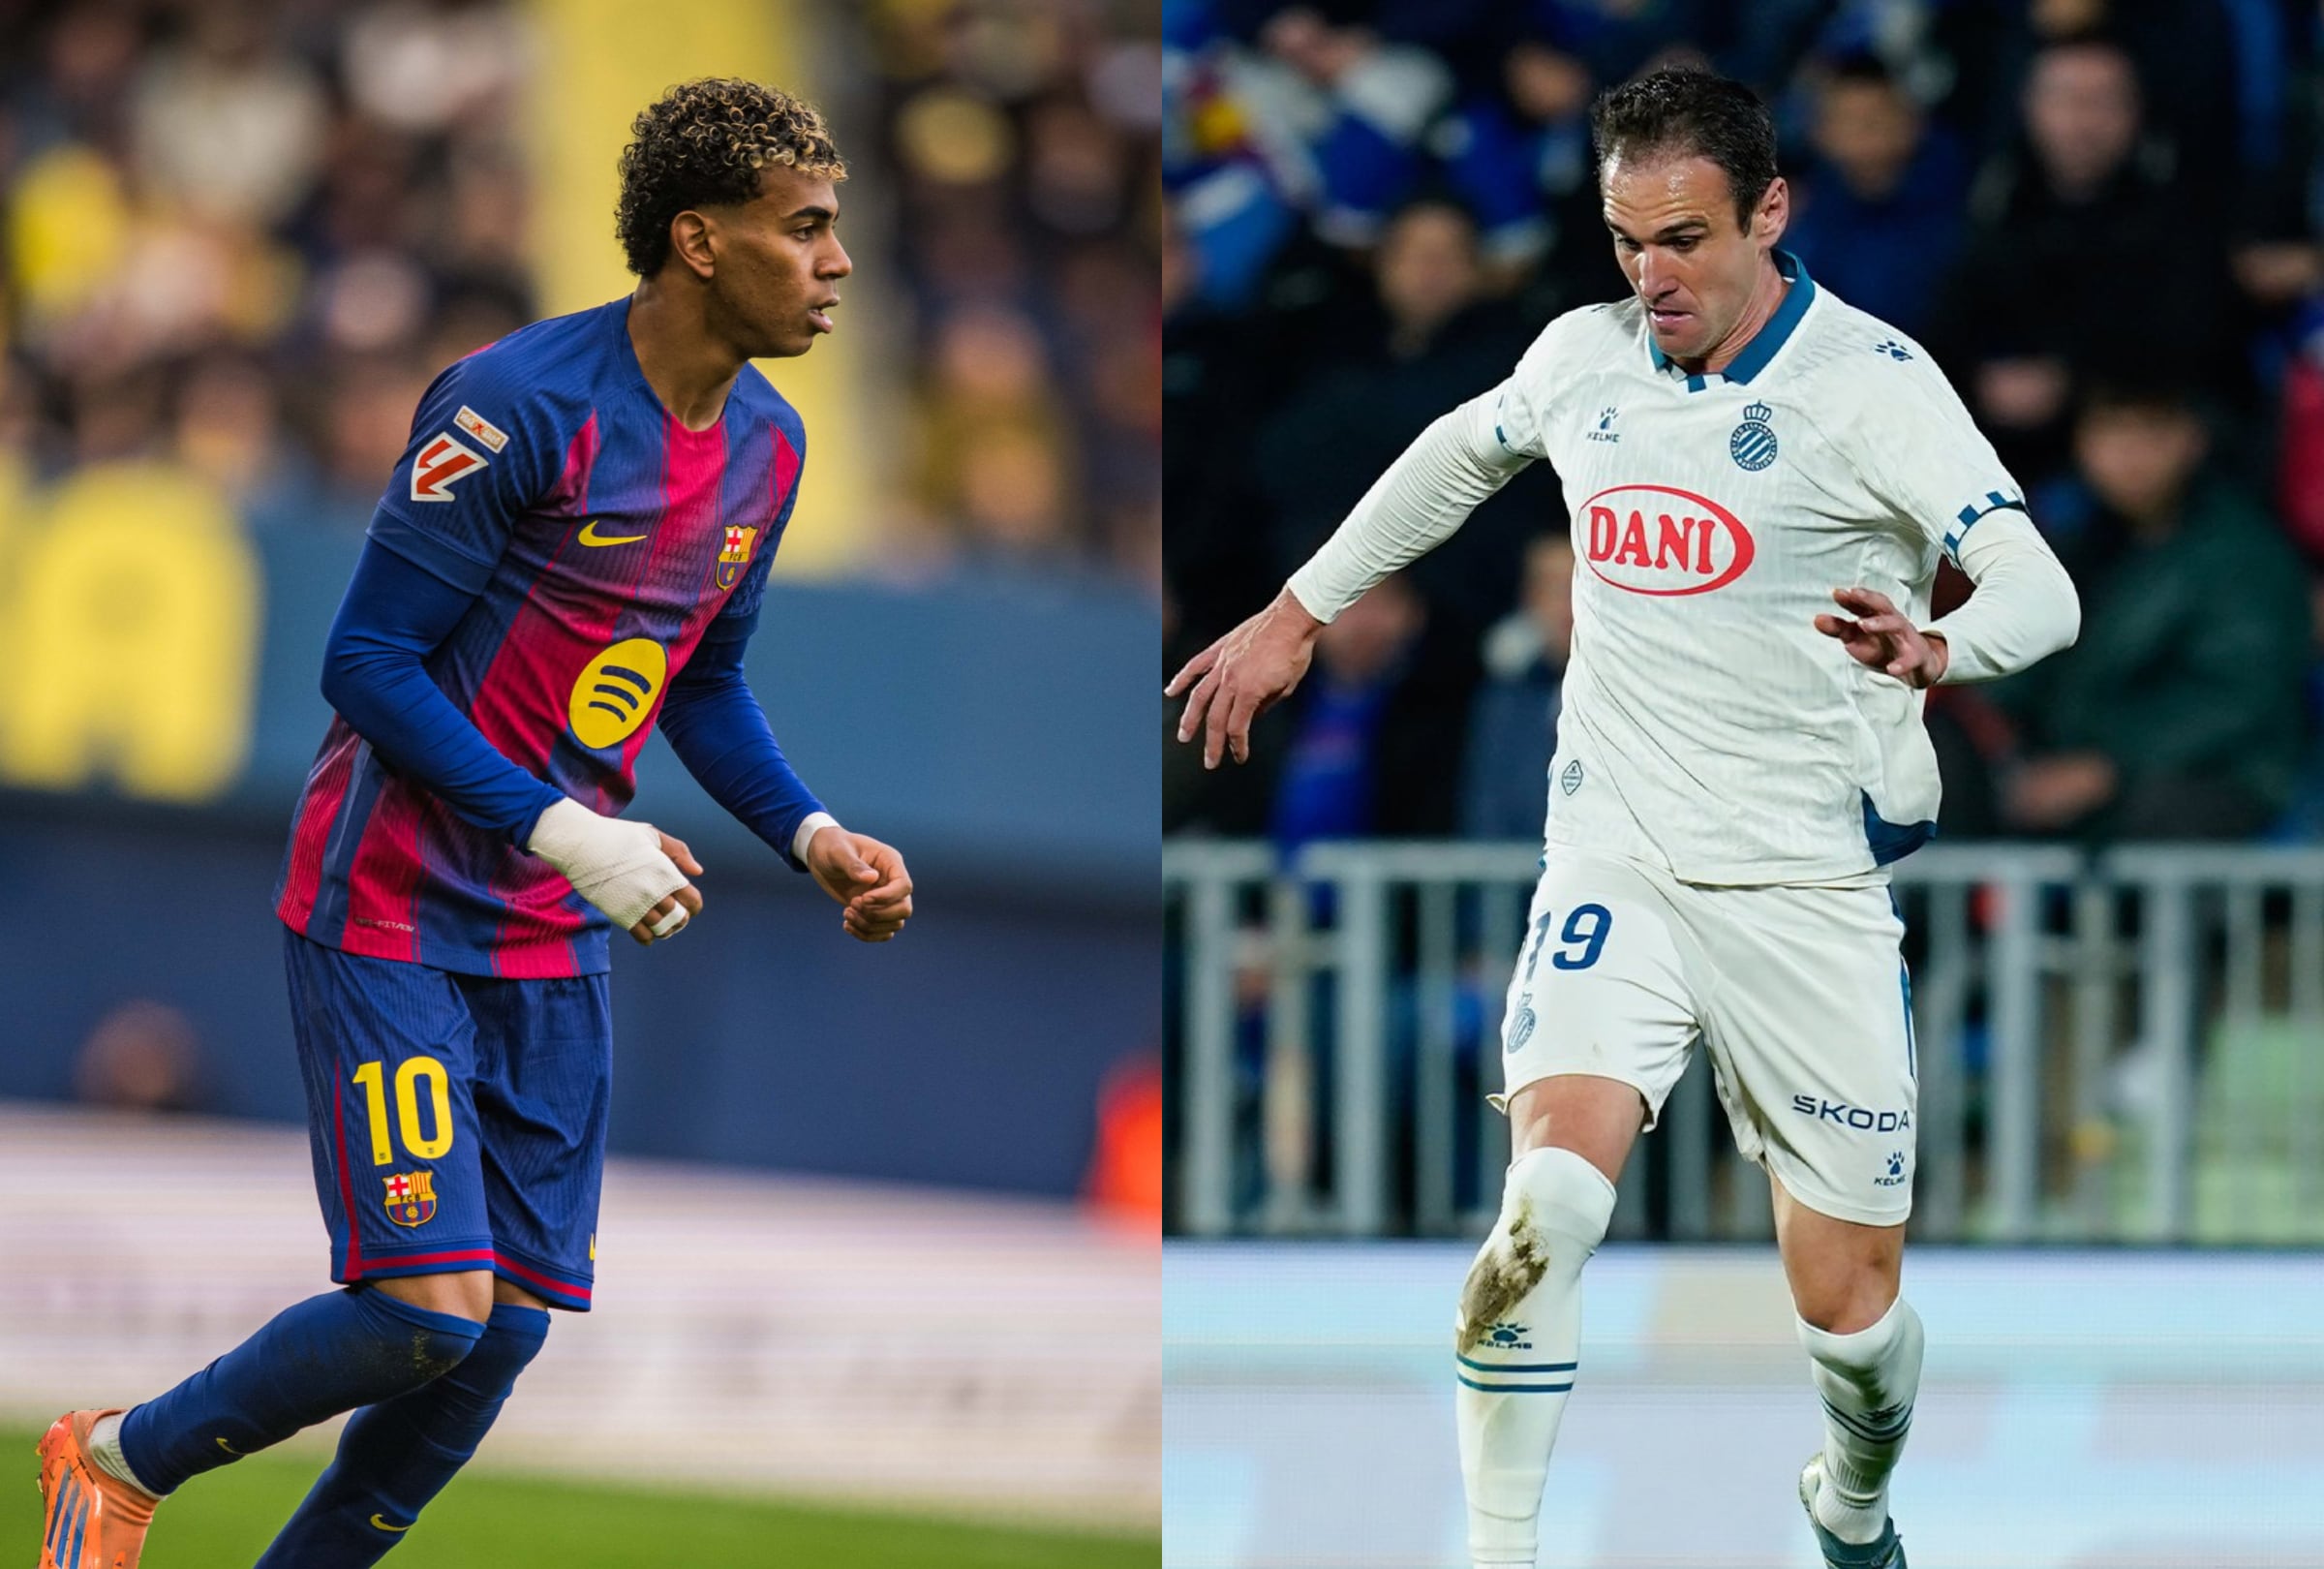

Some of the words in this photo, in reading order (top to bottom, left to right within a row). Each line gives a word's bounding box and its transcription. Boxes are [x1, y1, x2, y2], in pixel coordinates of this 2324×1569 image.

[1589, 506, 1716, 574] DANI
[352, 1055, 454, 1166] 10
[400, 1194, 421, 1203] FCB
